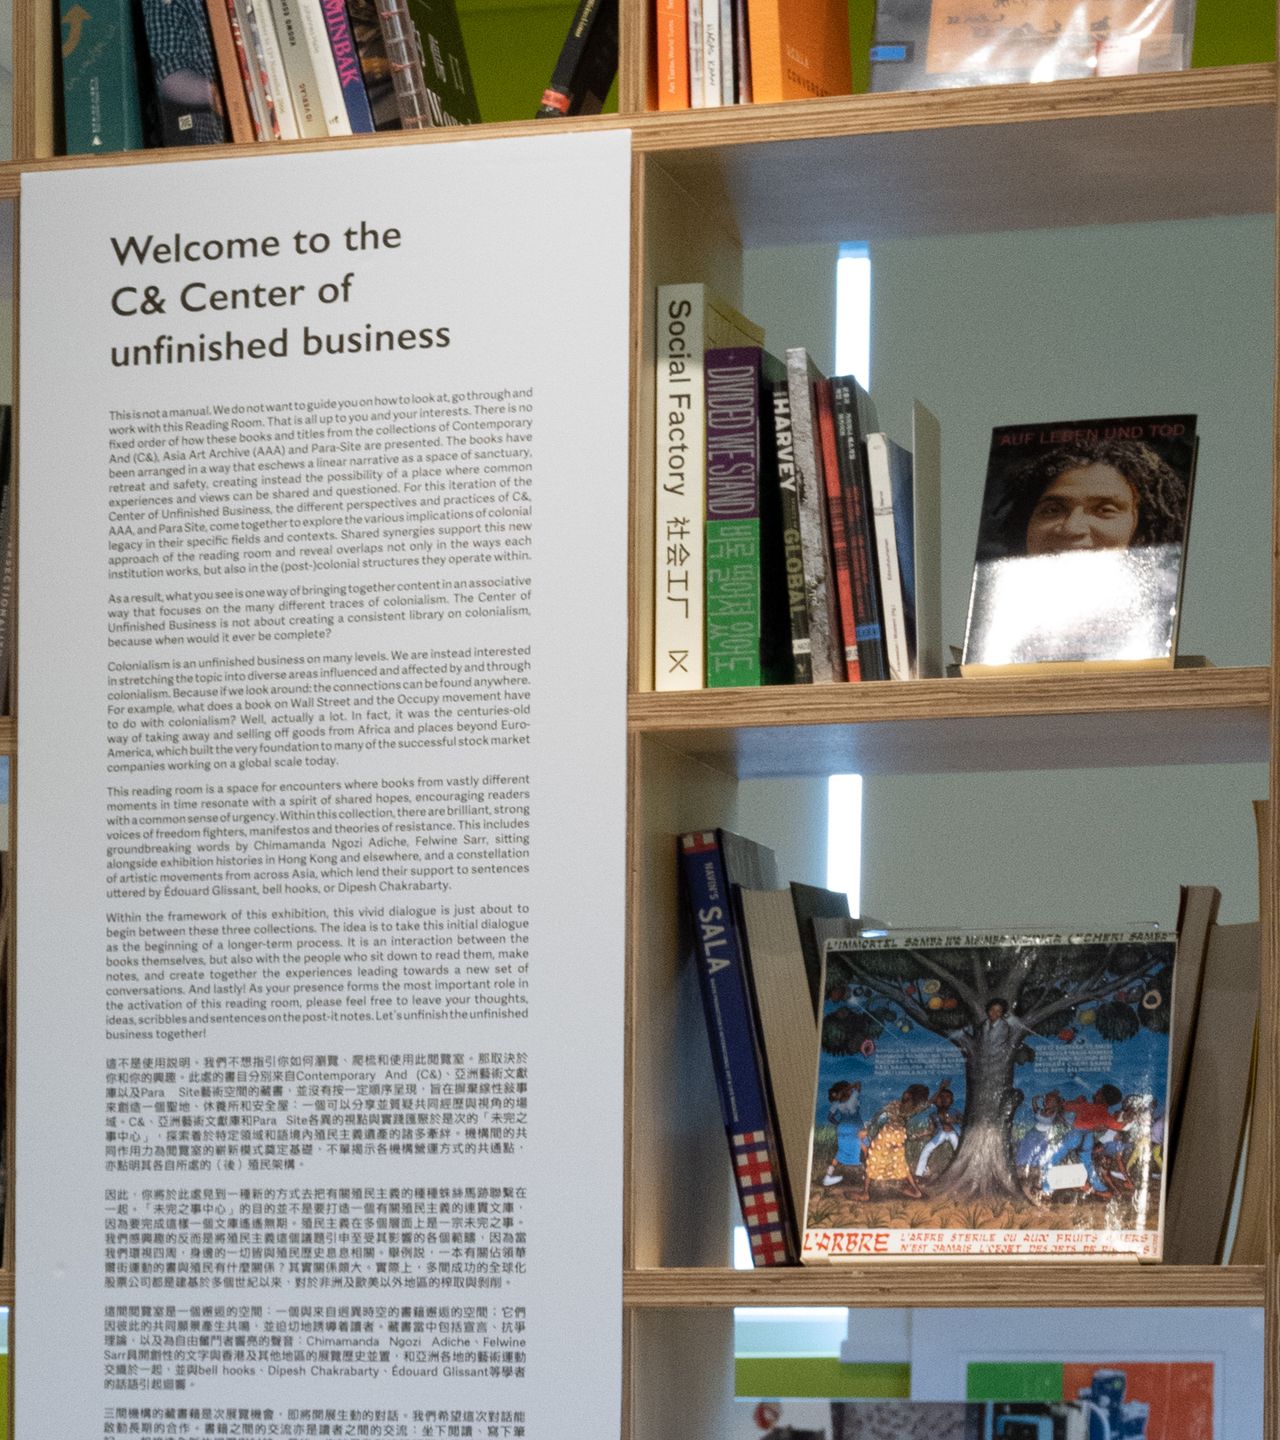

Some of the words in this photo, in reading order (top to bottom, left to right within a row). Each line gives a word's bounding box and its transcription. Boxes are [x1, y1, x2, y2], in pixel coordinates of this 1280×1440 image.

[109, 226, 279, 267] Welcome
[293, 229, 330, 255] to
[343, 218, 401, 251] the
[110, 283, 166, 317] C&
[180, 275, 305, 313] Center
[318, 272, 354, 304] of
[111, 326, 288, 367] unfinished
[303, 317, 450, 356] business
[667, 299, 692, 383] Social
[706, 365, 756, 430] DIVIDED
[108, 437, 135, 450] fixed
[136, 436, 166, 448] order
[168, 435, 179, 447] of
[181, 434, 204, 446] how
[206, 433, 237, 444] these
[239, 431, 272, 443] books
[274, 430, 294, 440] and
[296, 428, 324, 440] titles
[327, 427, 352, 438] from
[355, 426, 373, 436] the
[376, 422, 436, 435] collections
[438, 421, 449, 431] of
[452, 417, 531, 431] Contemporary
[663, 393, 690, 496] Factory
[707, 431, 755, 459] WE
[771, 397, 797, 493] HARVEY
[999, 431, 1034, 446] AUF
[1039, 428, 1099, 444] LEBEN
[1104, 425, 1143, 440] UND
[1150, 423, 1185, 438] TOD
[108, 481, 146, 493] retreat
[149, 479, 170, 491] and
[173, 477, 208, 492] safety,
[212, 475, 258, 490] creating
[261, 473, 301, 485] instead
[305, 472, 323, 482] the
[327, 469, 381, 484] possibility
[386, 468, 397, 478] of
[401, 470, 408, 478] a
[412, 466, 441, 479] place
[445, 464, 479, 475] where
[483, 463, 531, 473] common
[707, 462, 756, 514] STAND
[665, 516, 690, 619] 社会工厂
[781, 526, 807, 618] GLOBAL
[693, 903, 735, 975] SALA
